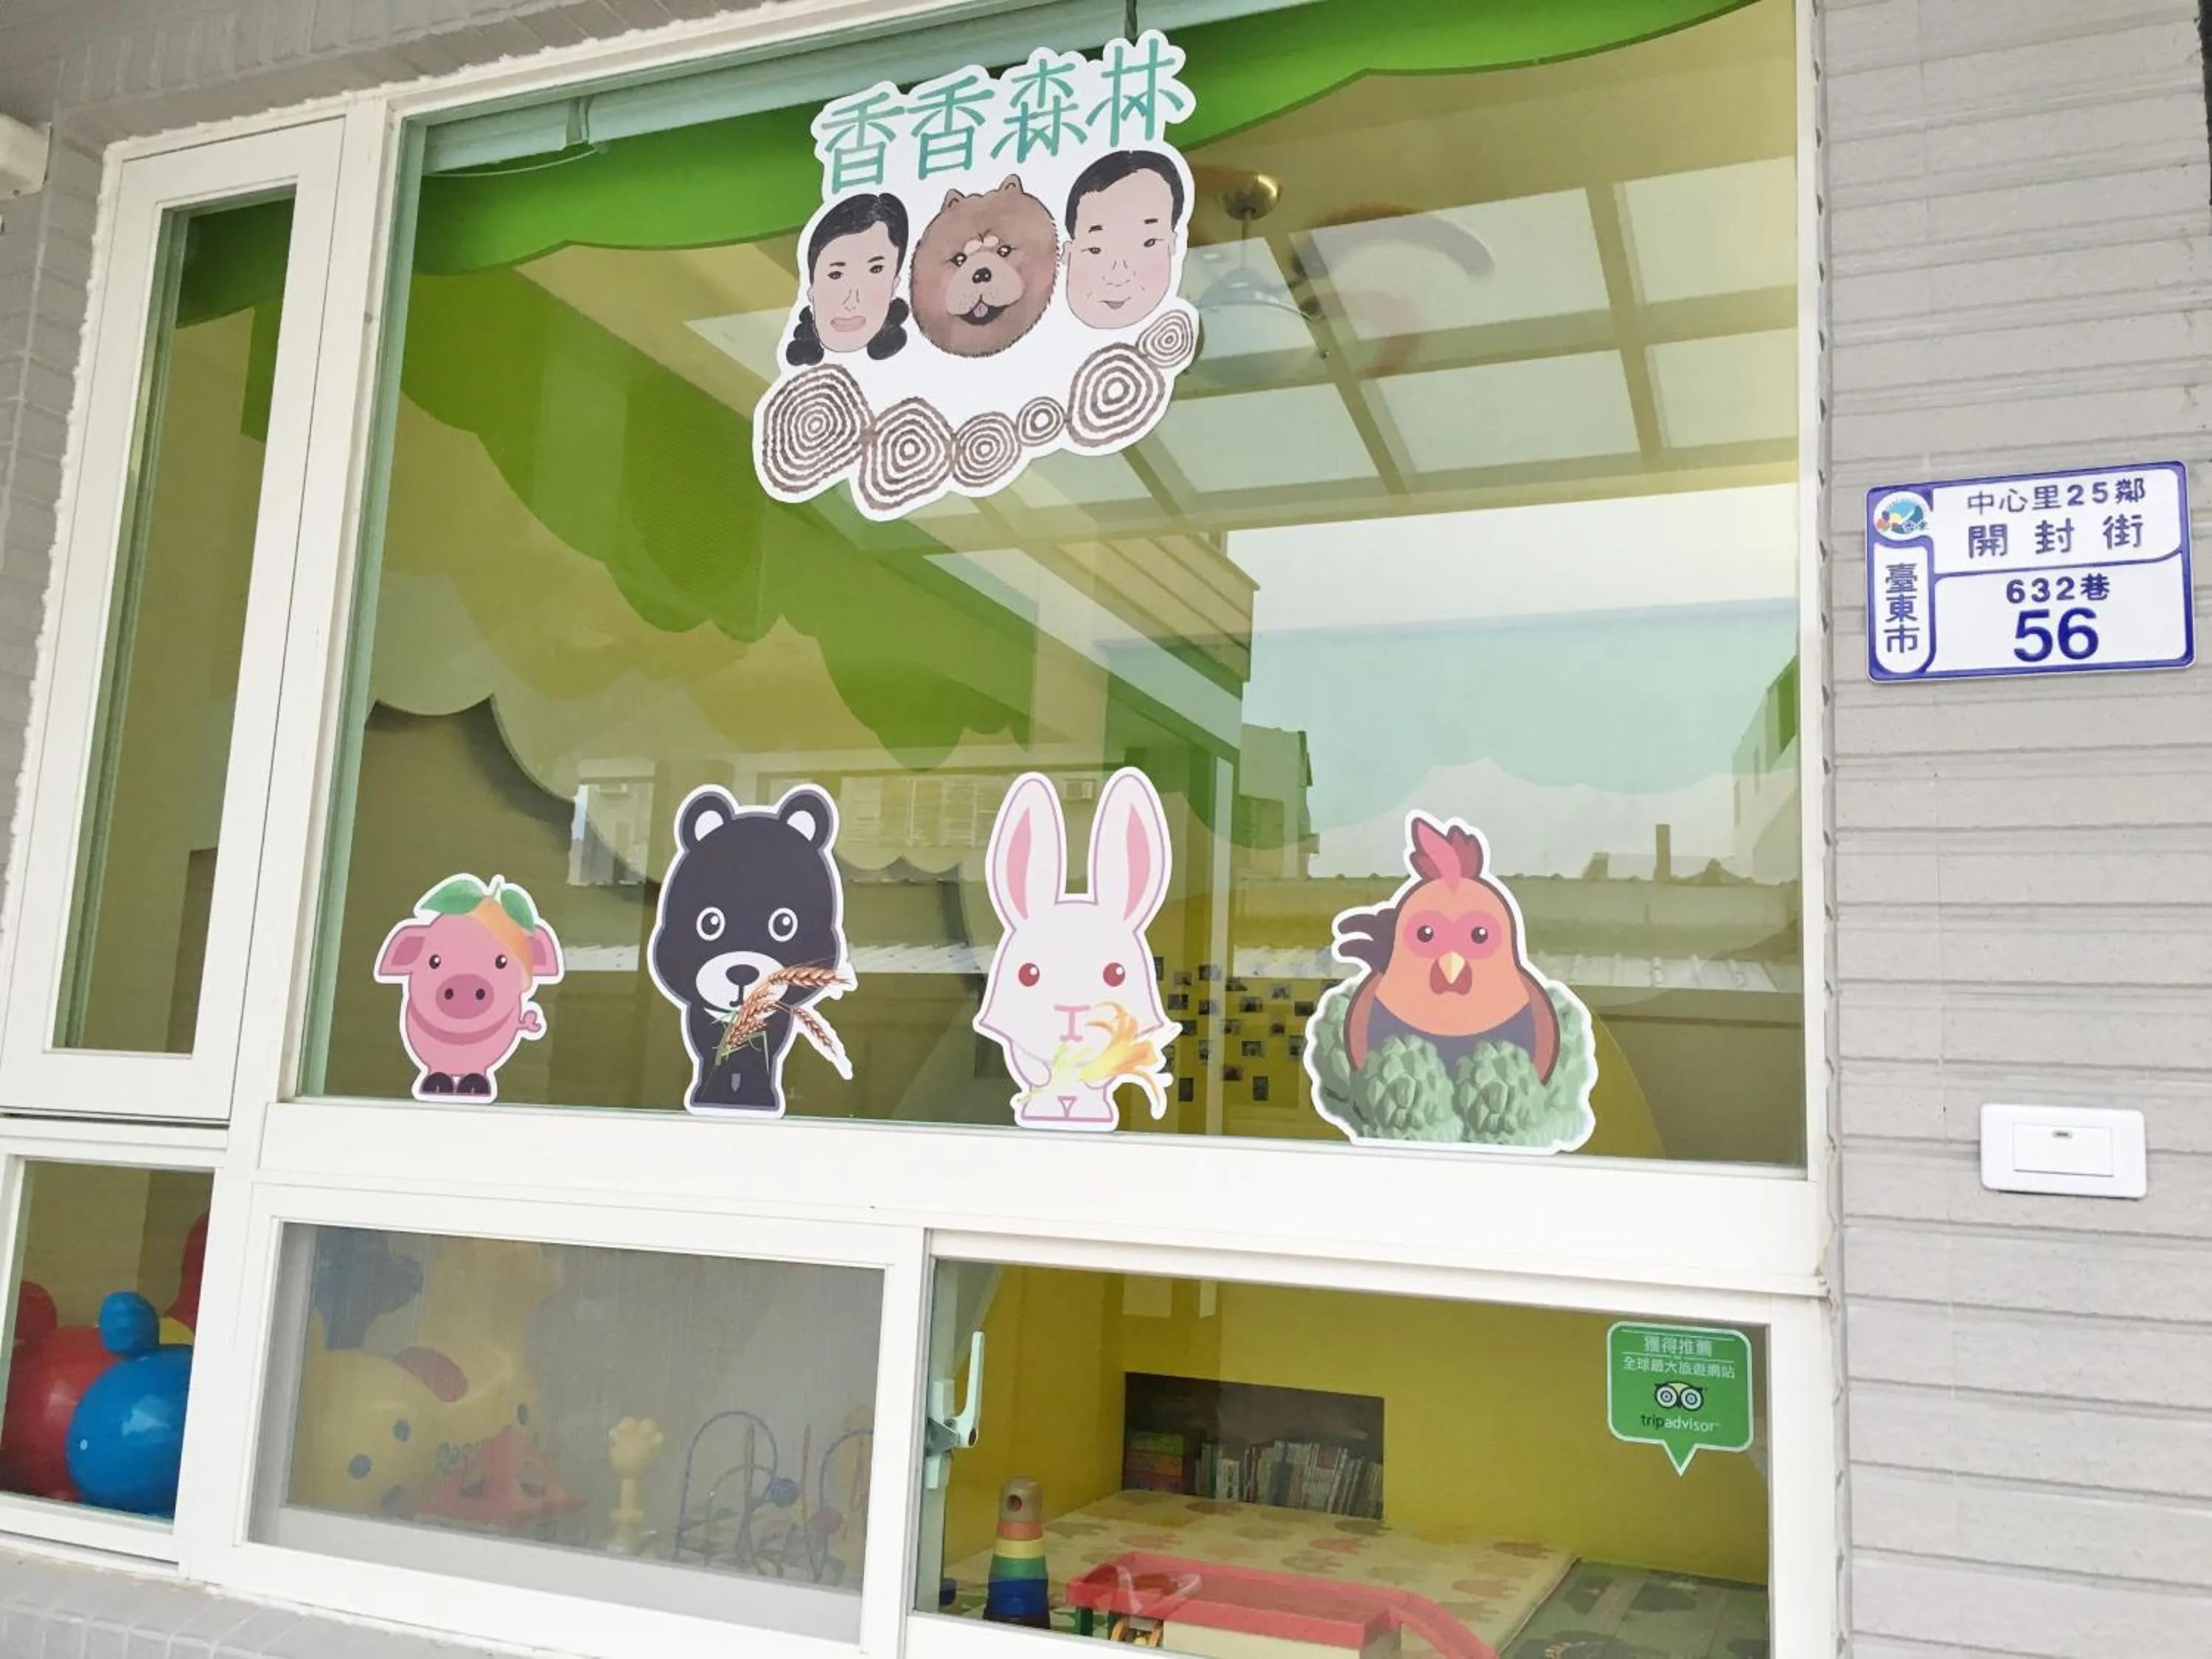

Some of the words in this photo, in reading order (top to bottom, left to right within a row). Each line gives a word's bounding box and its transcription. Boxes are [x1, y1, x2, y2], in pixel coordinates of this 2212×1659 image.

[821, 38, 1186, 195] 香香森林
[1966, 477, 2146, 515] 中心里25鄰
[1967, 514, 2143, 559] 開封街
[1884, 562, 1919, 654] 臺東市
[2006, 573, 2111, 604] 632巷
[2013, 607, 2099, 662] 56
[1641, 1413, 1717, 1432] tripadvisor
